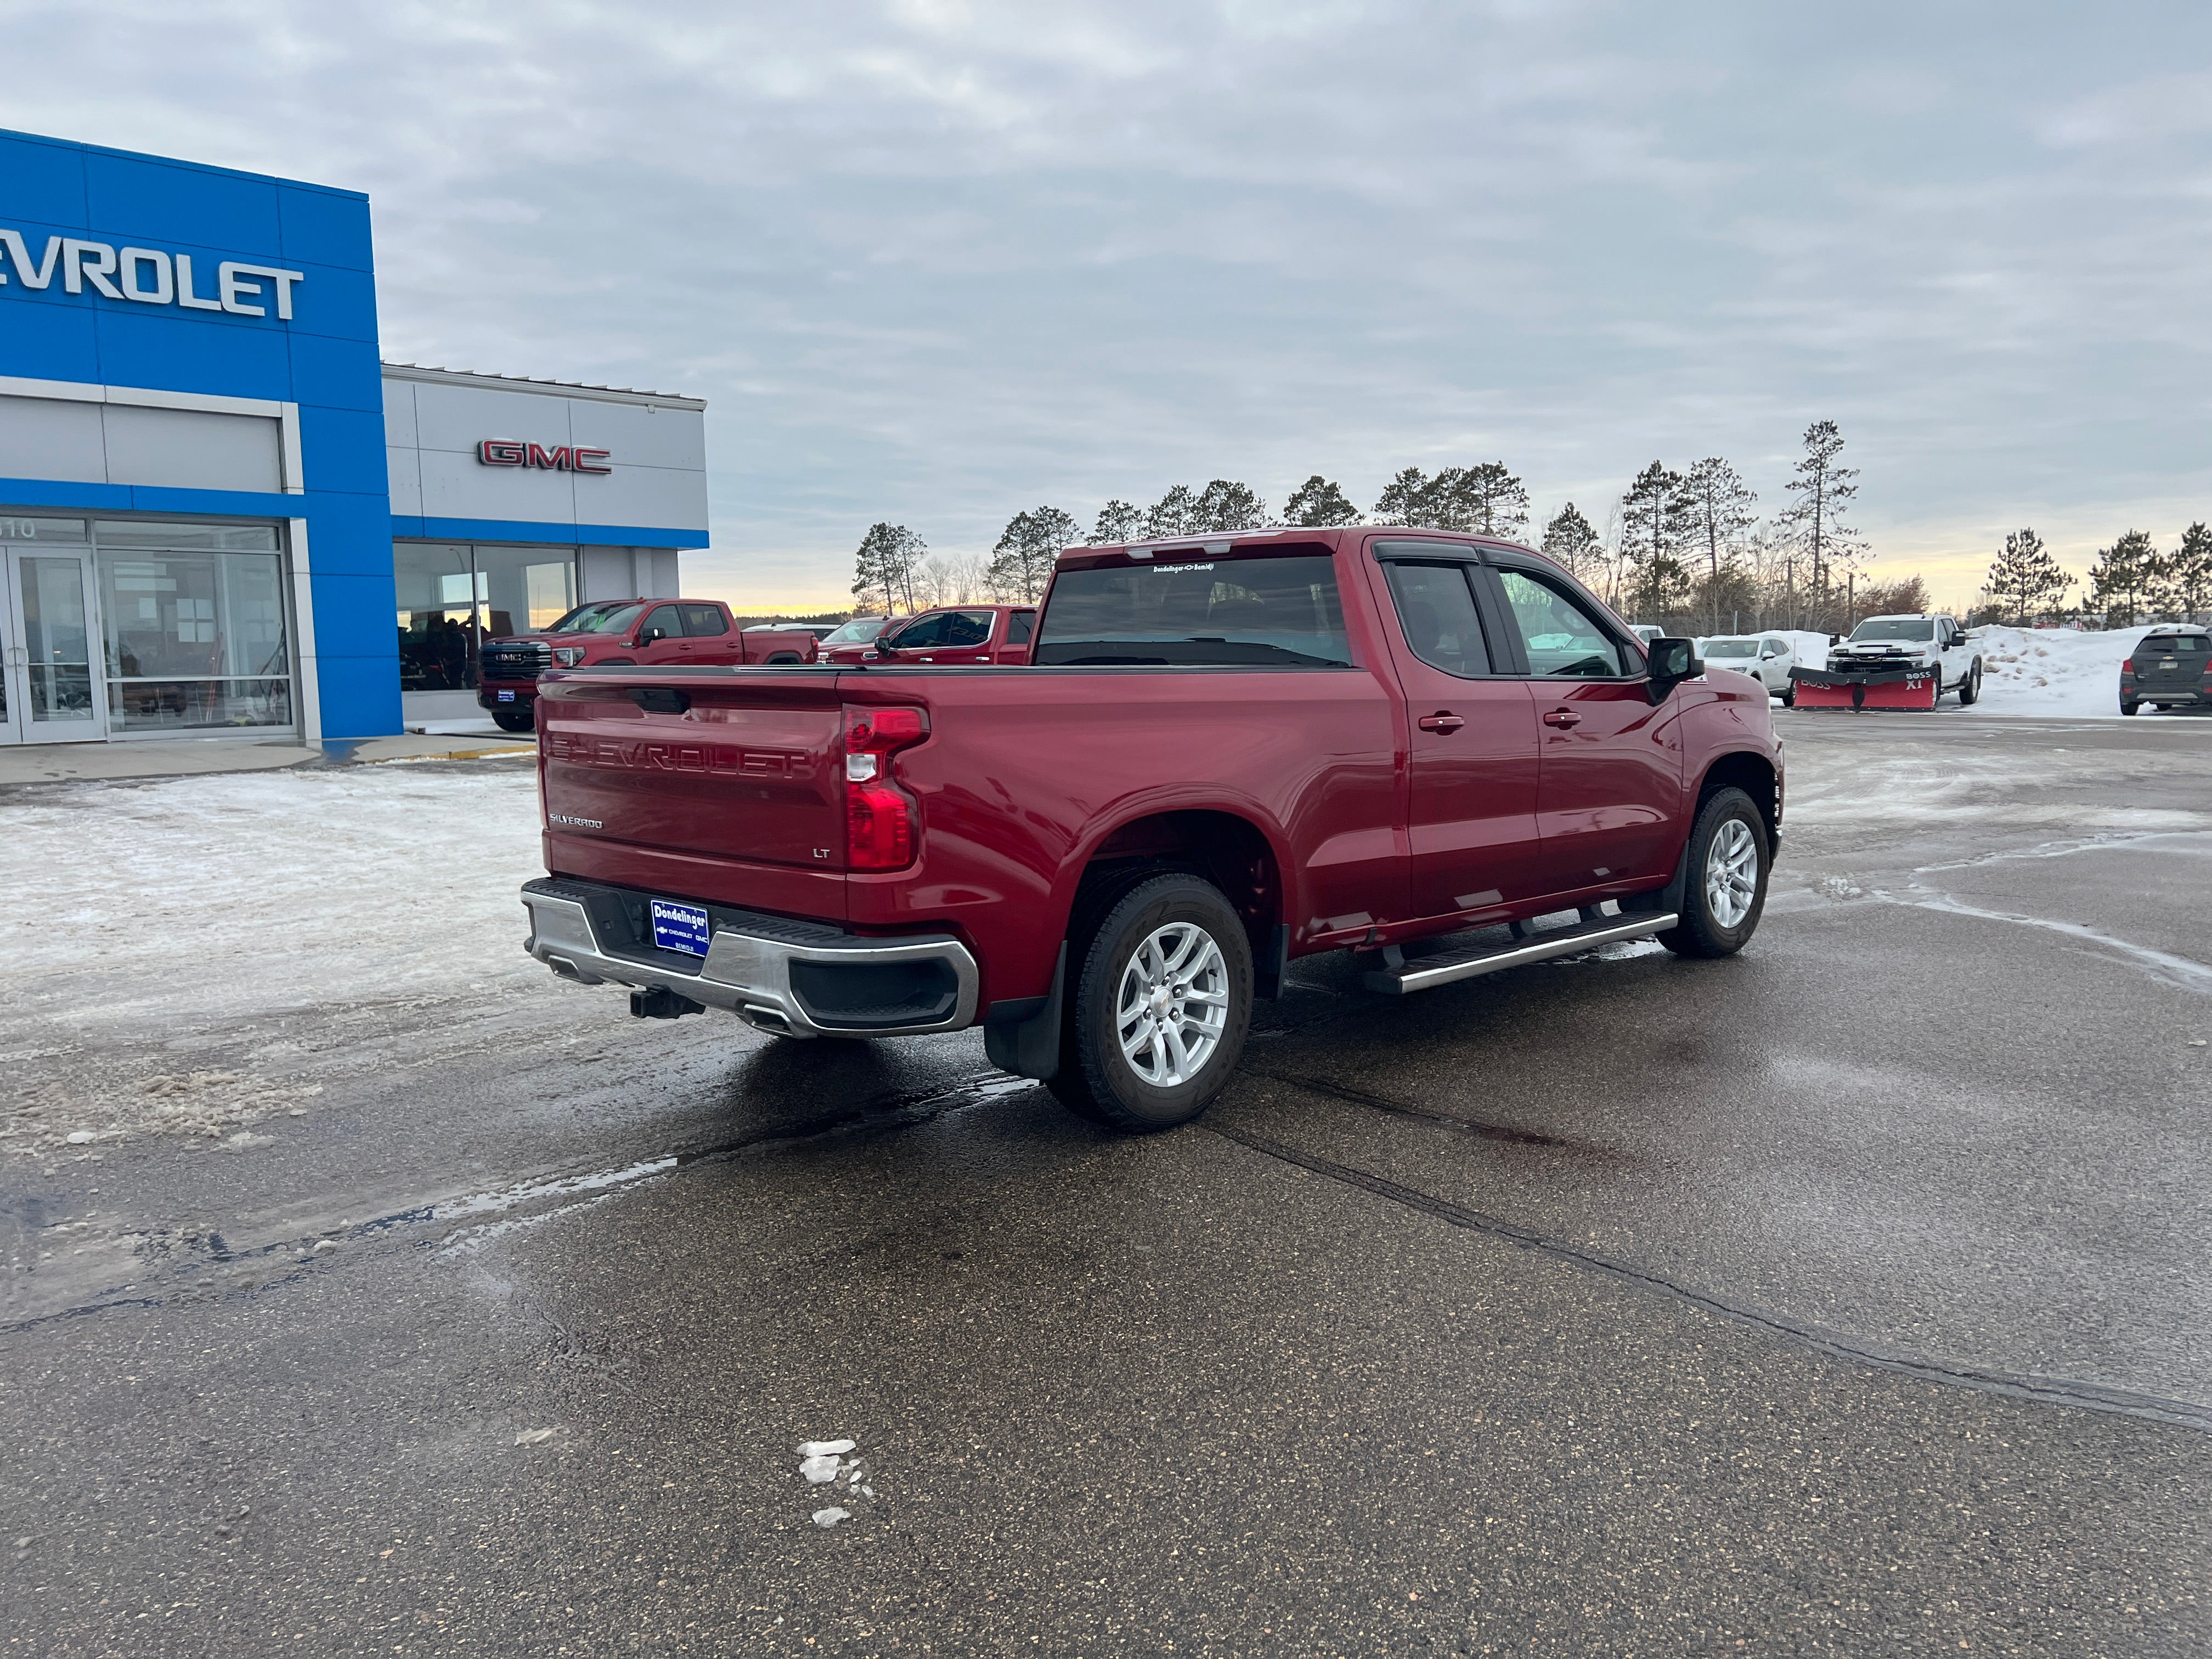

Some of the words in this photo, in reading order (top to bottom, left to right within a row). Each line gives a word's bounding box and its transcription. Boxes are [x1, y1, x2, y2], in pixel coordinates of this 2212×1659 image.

[0, 229, 303, 320] VROLET
[477, 439, 612, 474] GMC
[0, 520, 35, 538] 10
[551, 738, 806, 778] CHEVROLET
[550, 813, 602, 828] SILVERADO
[814, 848, 830, 858] LT
[654, 905, 706, 929] Dondelinger
[669, 929, 692, 938] CHEVROLET
[696, 935, 708, 943] GMC
[675, 943, 694, 952] BEMIDJI
